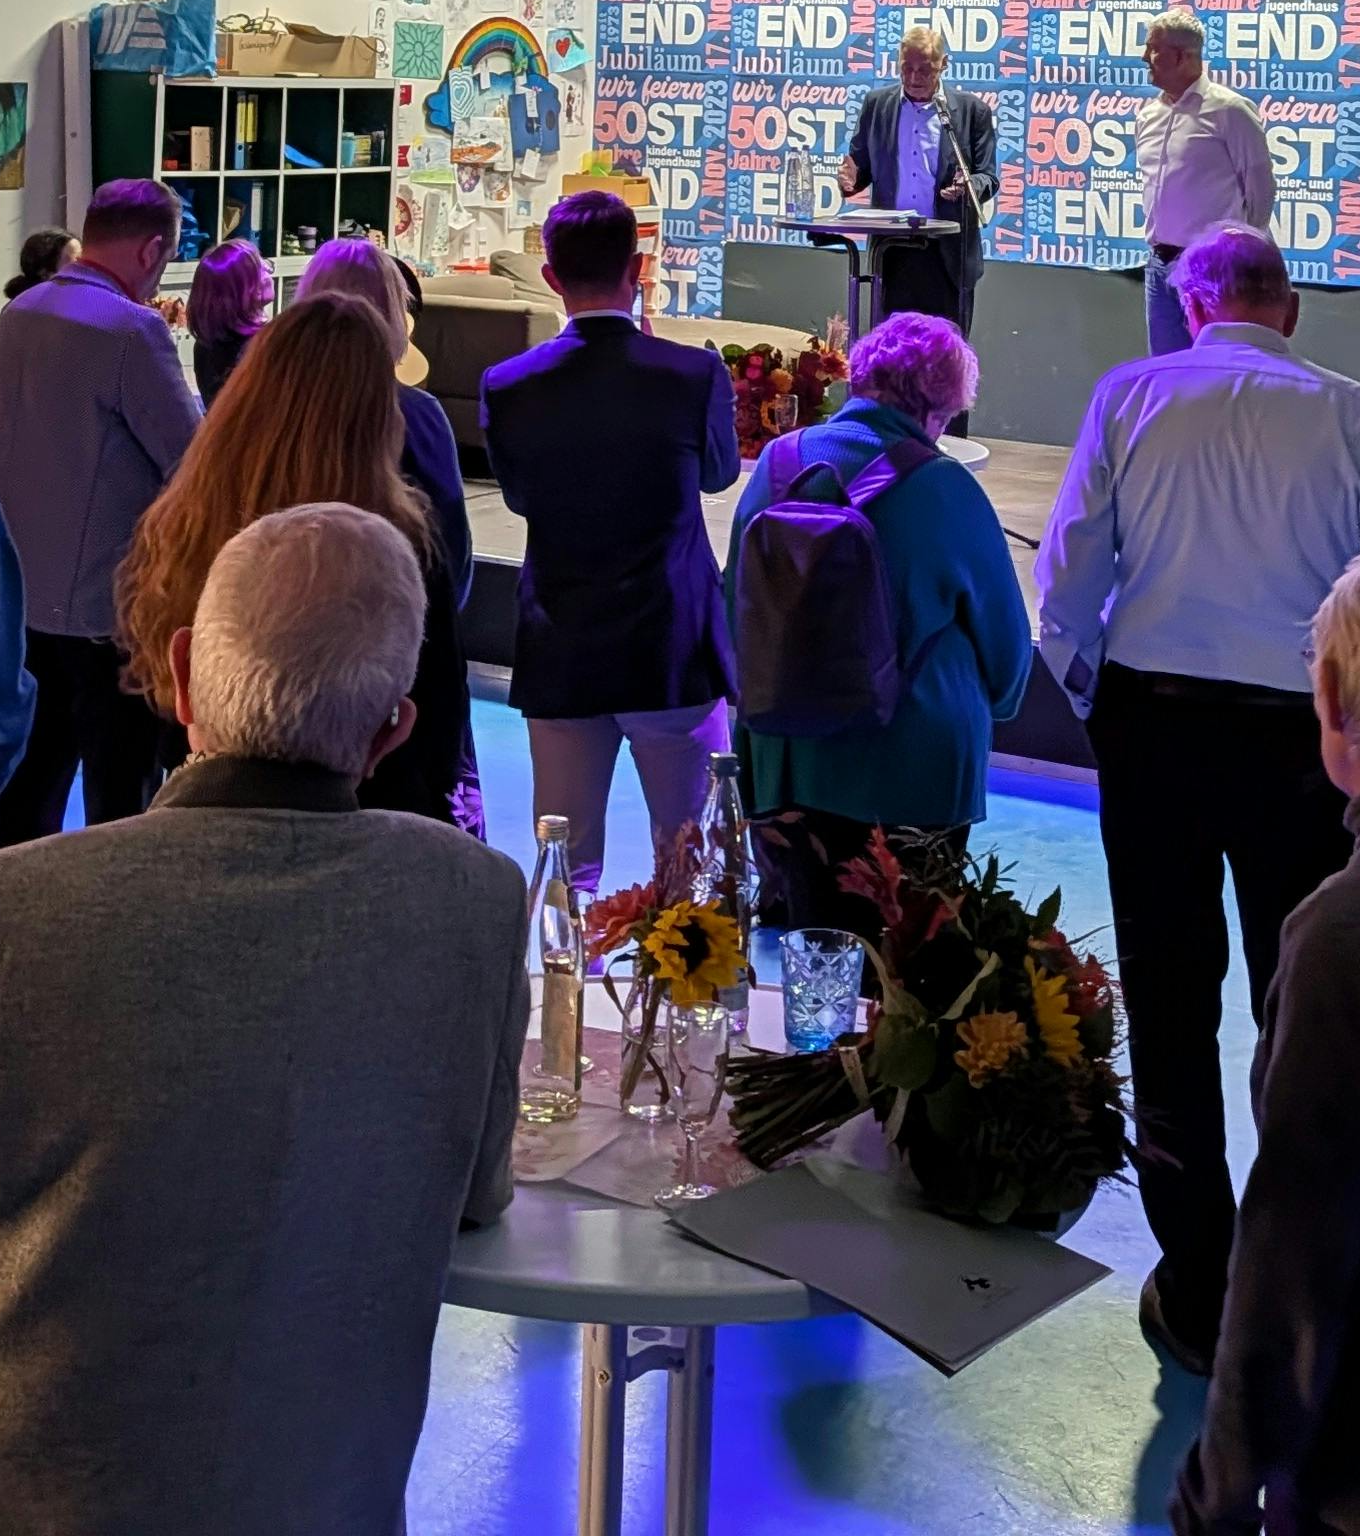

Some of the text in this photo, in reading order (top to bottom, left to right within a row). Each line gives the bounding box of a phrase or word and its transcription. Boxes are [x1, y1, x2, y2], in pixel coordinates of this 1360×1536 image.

[1265, 1, 1339, 14] jugendhaus
[621, 4, 705, 45] END
[757, 6, 847, 49] END
[1042, 14, 1057, 54] 1973
[1208, 16, 1223, 59] 1973
[1226, 13, 1337, 61] END
[597, 45, 702, 72] Jubiläum
[732, 49, 844, 77] Jubiläum
[598, 75, 704, 104] wir feiern
[732, 79, 848, 111] wir feiern
[1031, 89, 1079, 113] wir
[703, 80, 728, 196] NOV. 2023
[997, 89, 1025, 214] NOV. 2023
[728, 150, 781, 171] Jahre
[1026, 165, 1086, 188] Jahre
[1090, 166, 1133, 179] kinder-
[1309, 179, 1333, 190] und
[1038, 192, 1052, 233] 1973
[696, 247, 722, 305] 2023
